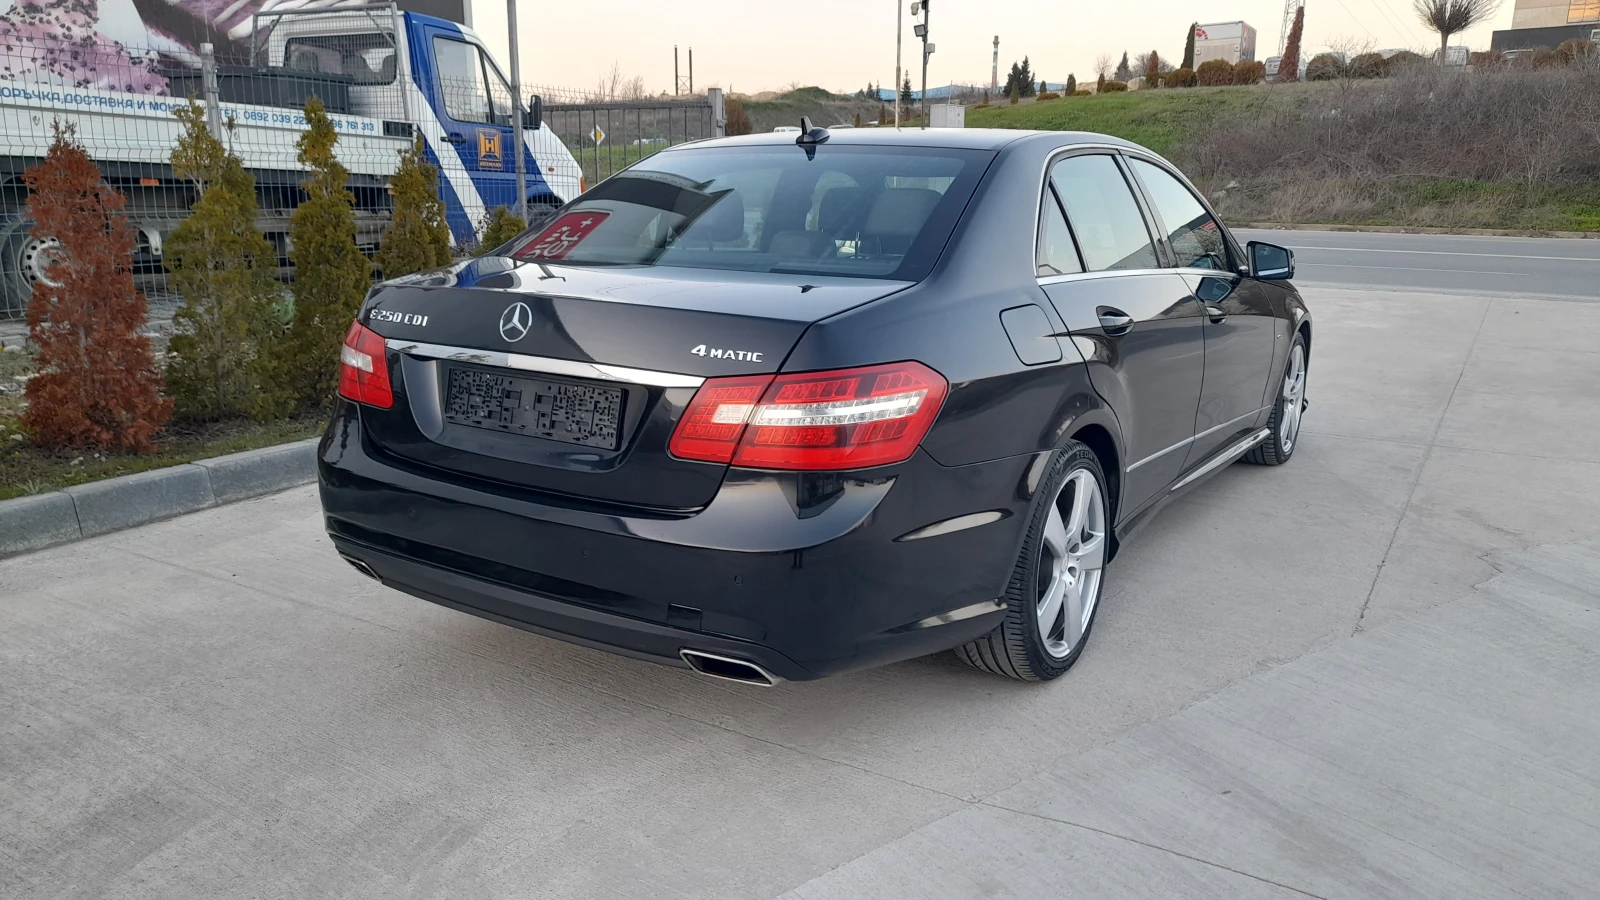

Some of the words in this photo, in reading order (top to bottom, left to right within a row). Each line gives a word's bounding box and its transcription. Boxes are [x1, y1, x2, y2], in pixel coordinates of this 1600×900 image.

[243, 110, 269, 121] 0892
[272, 113, 291, 124] 039
[361, 122, 375, 131] 313
[403, 313, 428, 327] CDI
